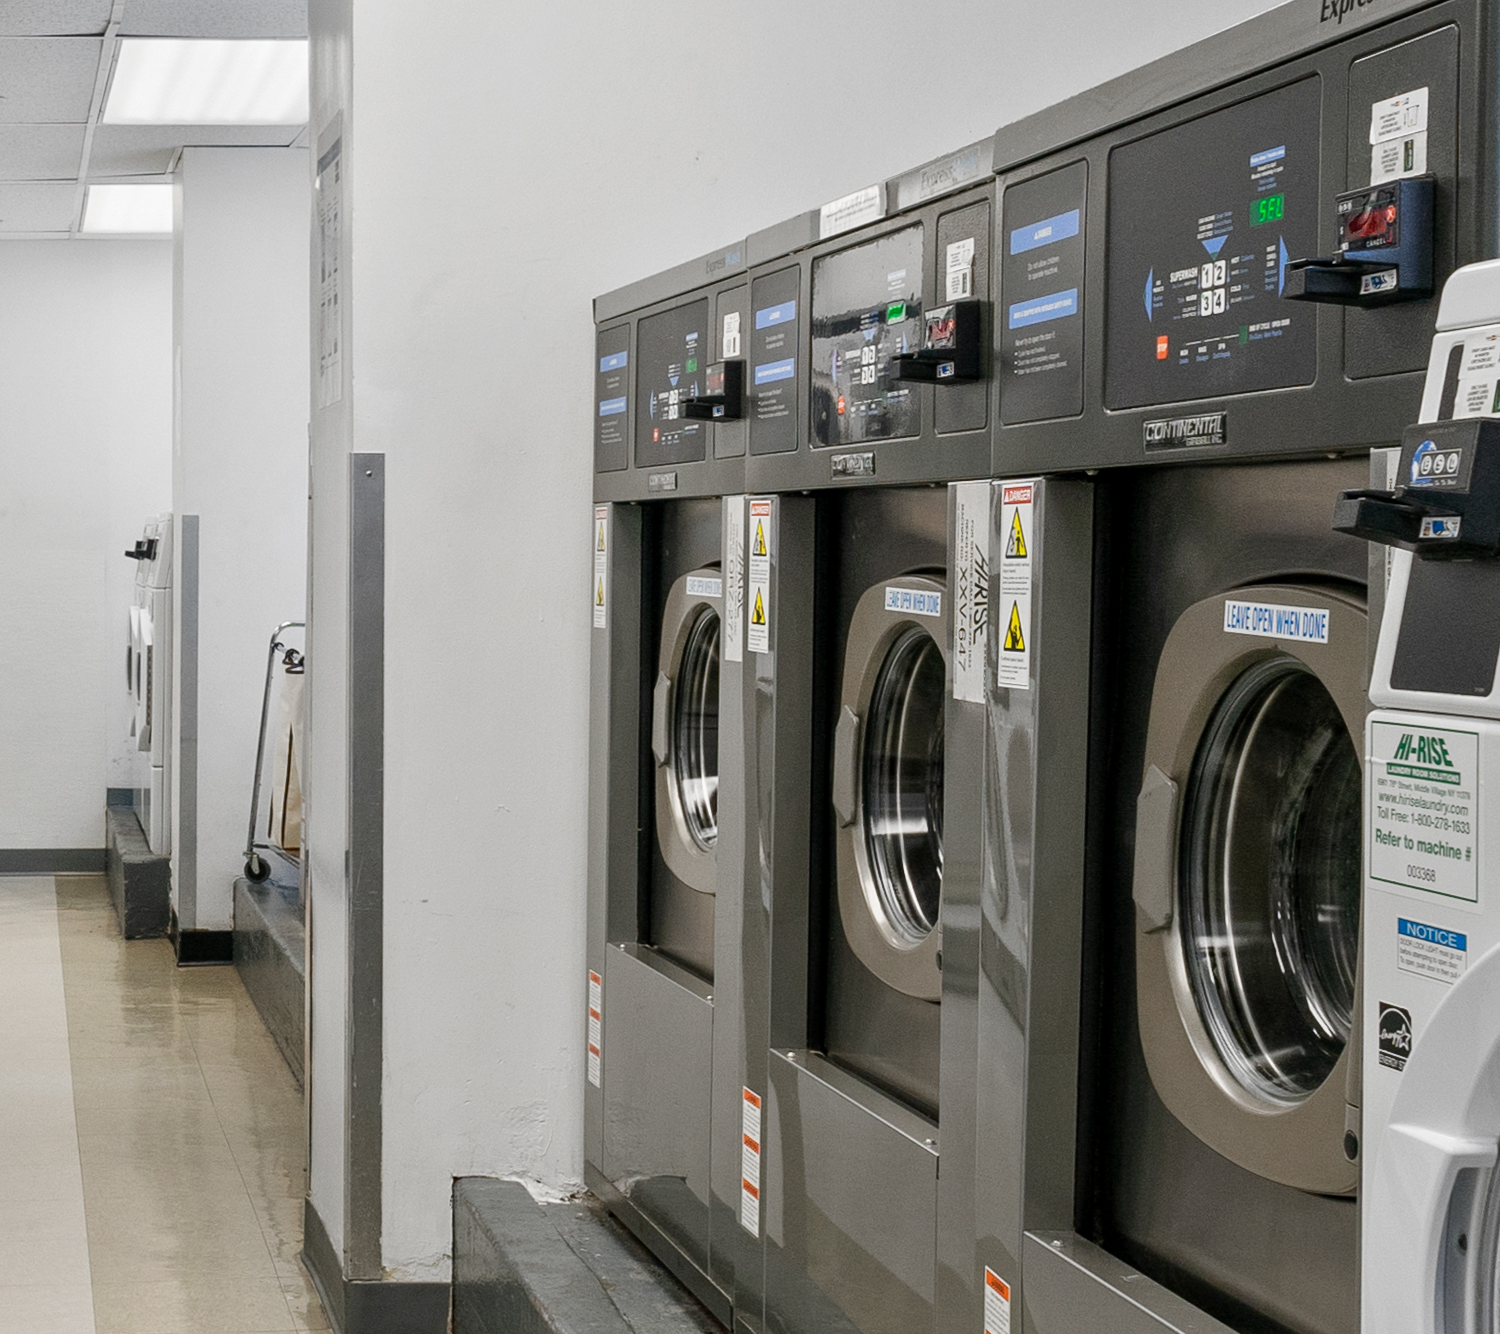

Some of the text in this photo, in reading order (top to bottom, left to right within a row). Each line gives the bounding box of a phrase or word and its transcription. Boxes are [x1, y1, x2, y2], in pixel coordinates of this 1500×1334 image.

[1258, 198, 1282, 222] SEL
[1366, 238, 1386, 248] CANCEL
[1170, 267, 1198, 283] SUPERWASH
[1157, 343, 1168, 353] STOP
[1146, 415, 1223, 440] CONTINENTAL
[1009, 487, 1031, 503] DANGER
[1227, 604, 1327, 639] LEAVE OPEN WHEN DONE
[1393, 733, 1454, 767] HI-RISE
[1378, 791, 1469, 816] www.hiriselaundry.com
[1377, 806, 1470, 835] Toll Free: 1-800-278-1633
[1375, 828, 1471, 862] Refer to machine #
[1407, 864, 1436, 882] 003368
[1406, 922, 1458, 947] NOTICE
